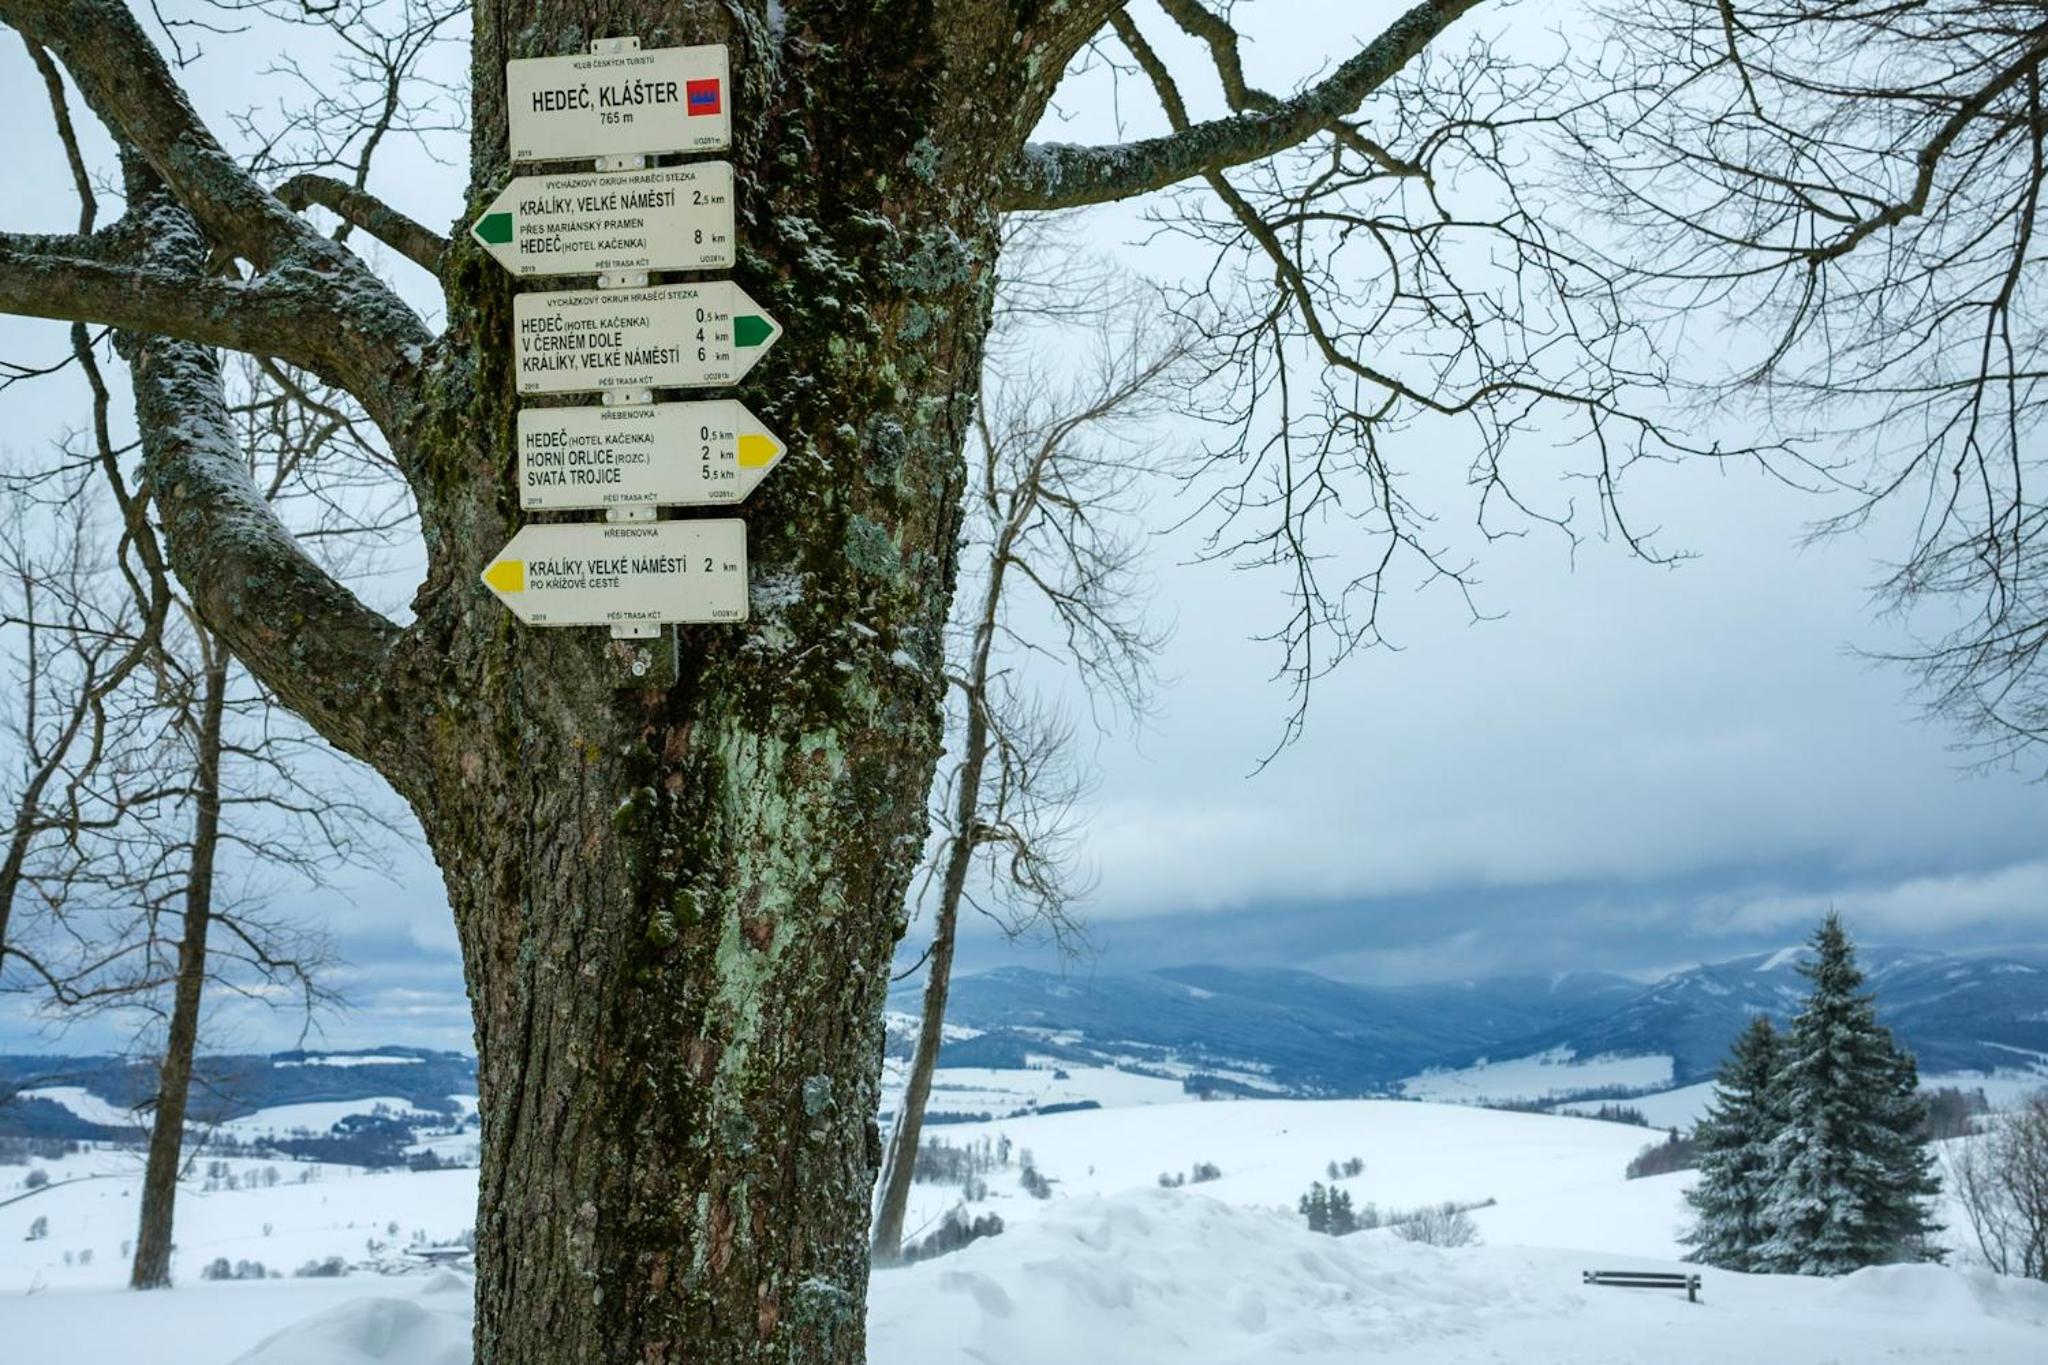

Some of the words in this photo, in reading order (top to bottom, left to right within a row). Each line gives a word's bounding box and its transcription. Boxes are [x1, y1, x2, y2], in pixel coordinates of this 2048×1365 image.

[533, 84, 595, 112] HEDEČ,
[600, 79, 678, 107] KLÁŠTER
[601, 113, 620, 124] 765
[623, 114, 633, 123] m
[599, 176, 627, 186] OKRUH
[666, 173, 696, 182] STEZKA
[519, 196, 574, 216] KRÁLÍKY,
[576, 192, 617, 212] VELKÉ
[620, 189, 675, 208] NÁMĚSTÍ
[693, 190, 709, 206] 2,5
[711, 194, 725, 204] km
[520, 224, 545, 234] PŘES
[547, 220, 602, 233] MARIÁNSKÝ
[604, 218, 644, 229] PRAMEN
[520, 234, 561, 254] HEDEČ
[597, 237, 647, 251] KAČENKA)
[694, 230, 702, 244] 8
[712, 233, 725, 243] km
[601, 294, 629, 304] OKRUH
[668, 290, 699, 300] STEZKA
[521, 313, 563, 333] HEDEČ
[600, 316, 650, 329] KAČENKA)
[696, 308, 712, 323] 0,5
[715, 312, 728, 321] km
[522, 338, 530, 352] V
[534, 334, 585, 351] ČERNÉM
[589, 335, 622, 348] DOLE
[696, 329, 704, 342] 4
[715, 332, 729, 341] km
[522, 354, 578, 372] KRÁLÍKY,
[580, 351, 621, 369] VELKÉ
[625, 347, 680, 367] NÁMĚSTÍ
[698, 348, 706, 361] 6
[716, 351, 730, 361] km
[526, 428, 568, 447] HEDEČ
[605, 433, 655, 445] KAČENKA)
[701, 426, 717, 441] 0,5
[719, 431, 733, 440] km
[526, 448, 566, 467] HORNÍ
[569, 449, 614, 465] ORLICE
[702, 446, 710, 460] 2
[720, 450, 734, 459] km
[527, 467, 567, 486] SVATÁ
[569, 468, 621, 484] TROJICE
[702, 465, 719, 480] 5,5
[721, 470, 734, 479] km
[604, 527, 658, 538] HŘEBENOVKA
[529, 557, 585, 577] KRÁLÍKY,
[588, 556, 628, 575] VELKÉ
[632, 554, 687, 573] NÁMĚSTÍ
[704, 558, 713, 572] 2
[724, 562, 737, 572] km
[530, 580, 544, 589] PO
[546, 577, 587, 588] KŘÍŽOVÉ
